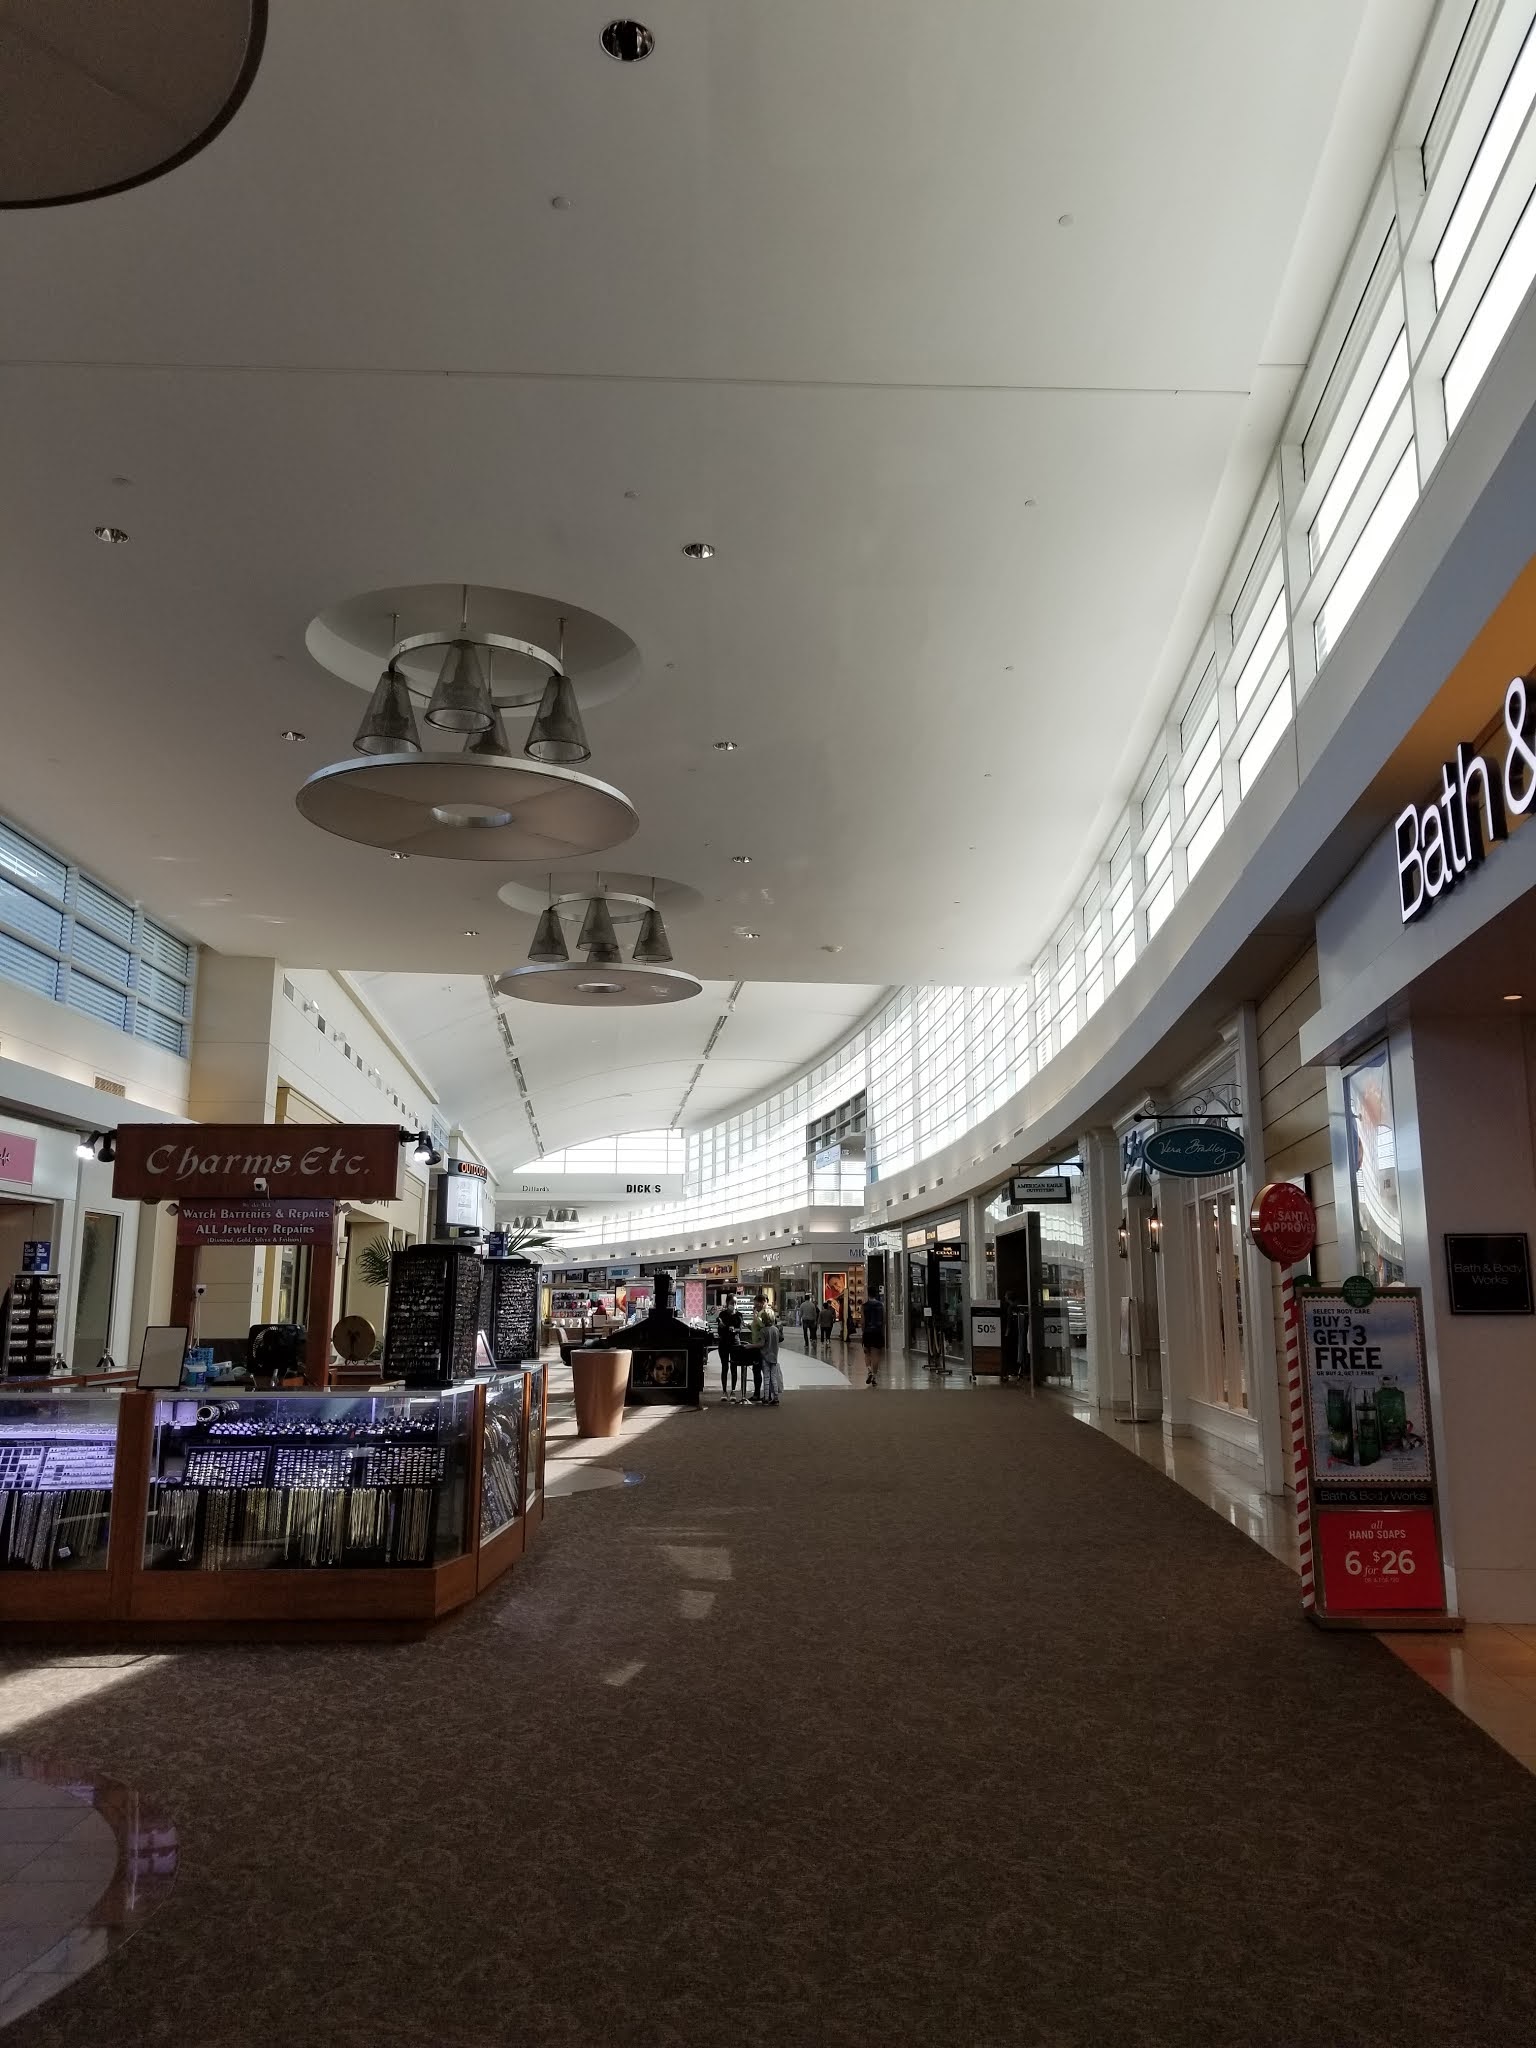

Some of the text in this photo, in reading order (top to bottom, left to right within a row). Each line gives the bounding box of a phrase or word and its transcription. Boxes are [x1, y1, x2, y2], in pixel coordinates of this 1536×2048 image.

[1395, 676, 1536, 924] Bath &
[1158, 1139, 1182, 1155] Vera
[1185, 1138, 1241, 1165] Bradley
[299, 1146, 371, 1175] Etc.
[275, 1209, 284, 1219] &
[1278, 1210, 1309, 1222] SANTA
[195, 1224, 218, 1235] ALL
[1263, 1221, 1316, 1233] APPROVED
[1454, 1263, 1524, 1274] Bath & Body
[1472, 1275, 1509, 1285] Works
[1313, 1316, 1352, 1327] BUY 3
[1313, 1325, 1367, 1346] GET 3
[1315, 1347, 1382, 1370] FREE
[1320, 1490, 1427, 1503] Bath & Body Works
[1370, 1520, 1384, 1530] all
[1349, 1529, 1407, 1540] HAND SOAPS
[1345, 1549, 1416, 1577] 6 for $26
